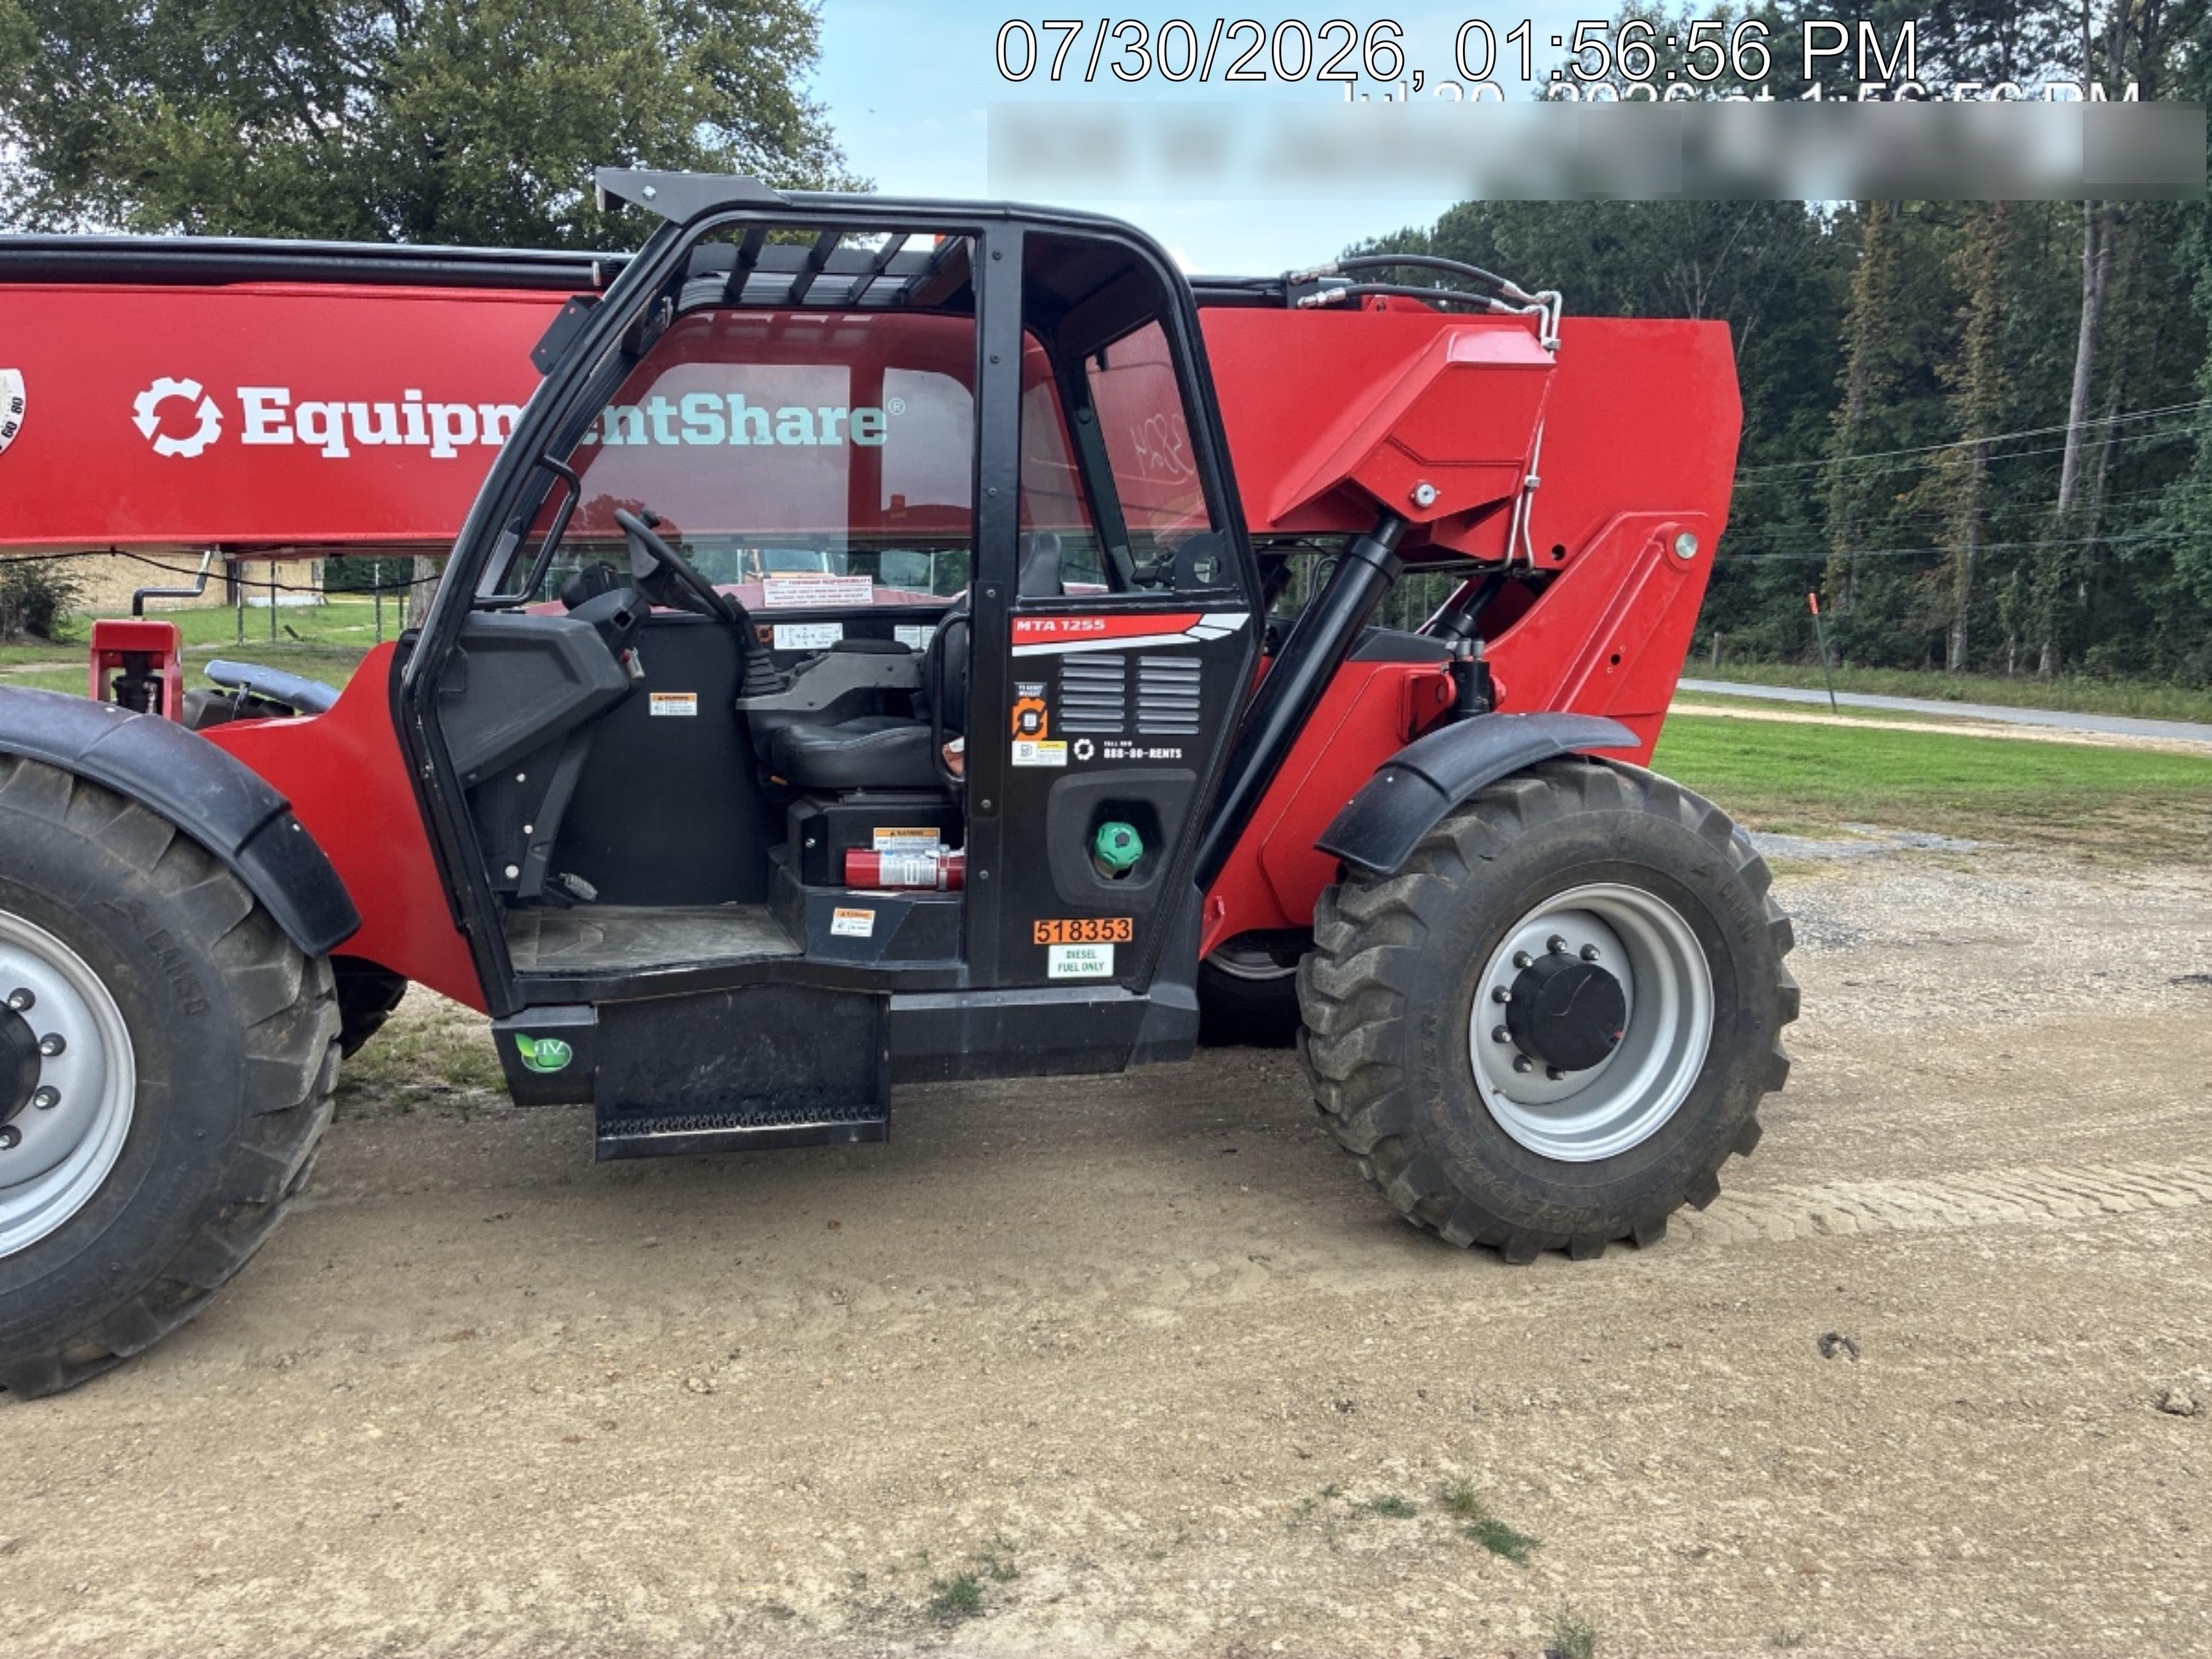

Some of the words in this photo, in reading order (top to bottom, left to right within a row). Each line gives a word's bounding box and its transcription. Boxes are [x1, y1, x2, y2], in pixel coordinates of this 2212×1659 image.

[237, 386, 906, 458] EquipntShare®
[1017, 620, 1056, 632] MTA
[1061, 618, 1105, 631] 1255
[1037, 920, 1130, 942] 518353
[1066, 949, 1097, 959] DIESEL
[1057, 962, 1080, 973] FUEL
[1081, 961, 1105, 972] ONLY
